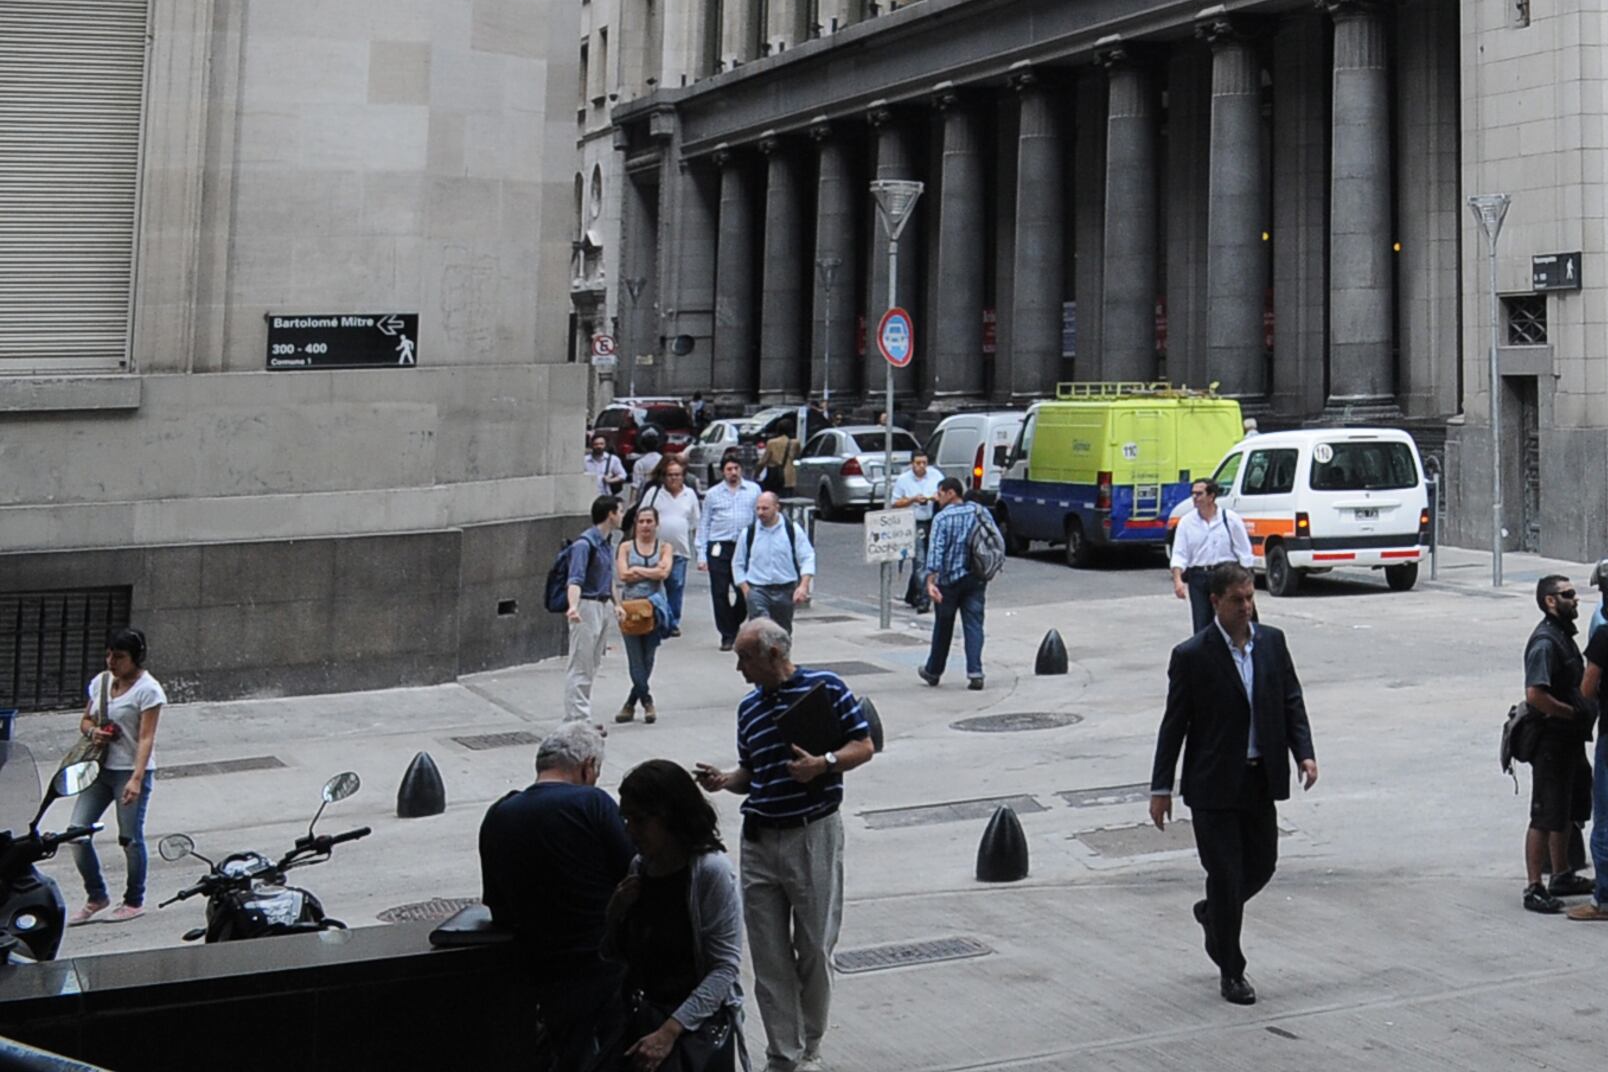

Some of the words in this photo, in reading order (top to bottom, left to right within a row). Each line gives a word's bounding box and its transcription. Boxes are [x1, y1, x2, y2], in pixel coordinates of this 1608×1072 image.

[273, 317, 338, 328] Bartolomé
[340, 316, 374, 328] Mitre
[271, 344, 295, 355] 300
[304, 343, 328, 354] 400
